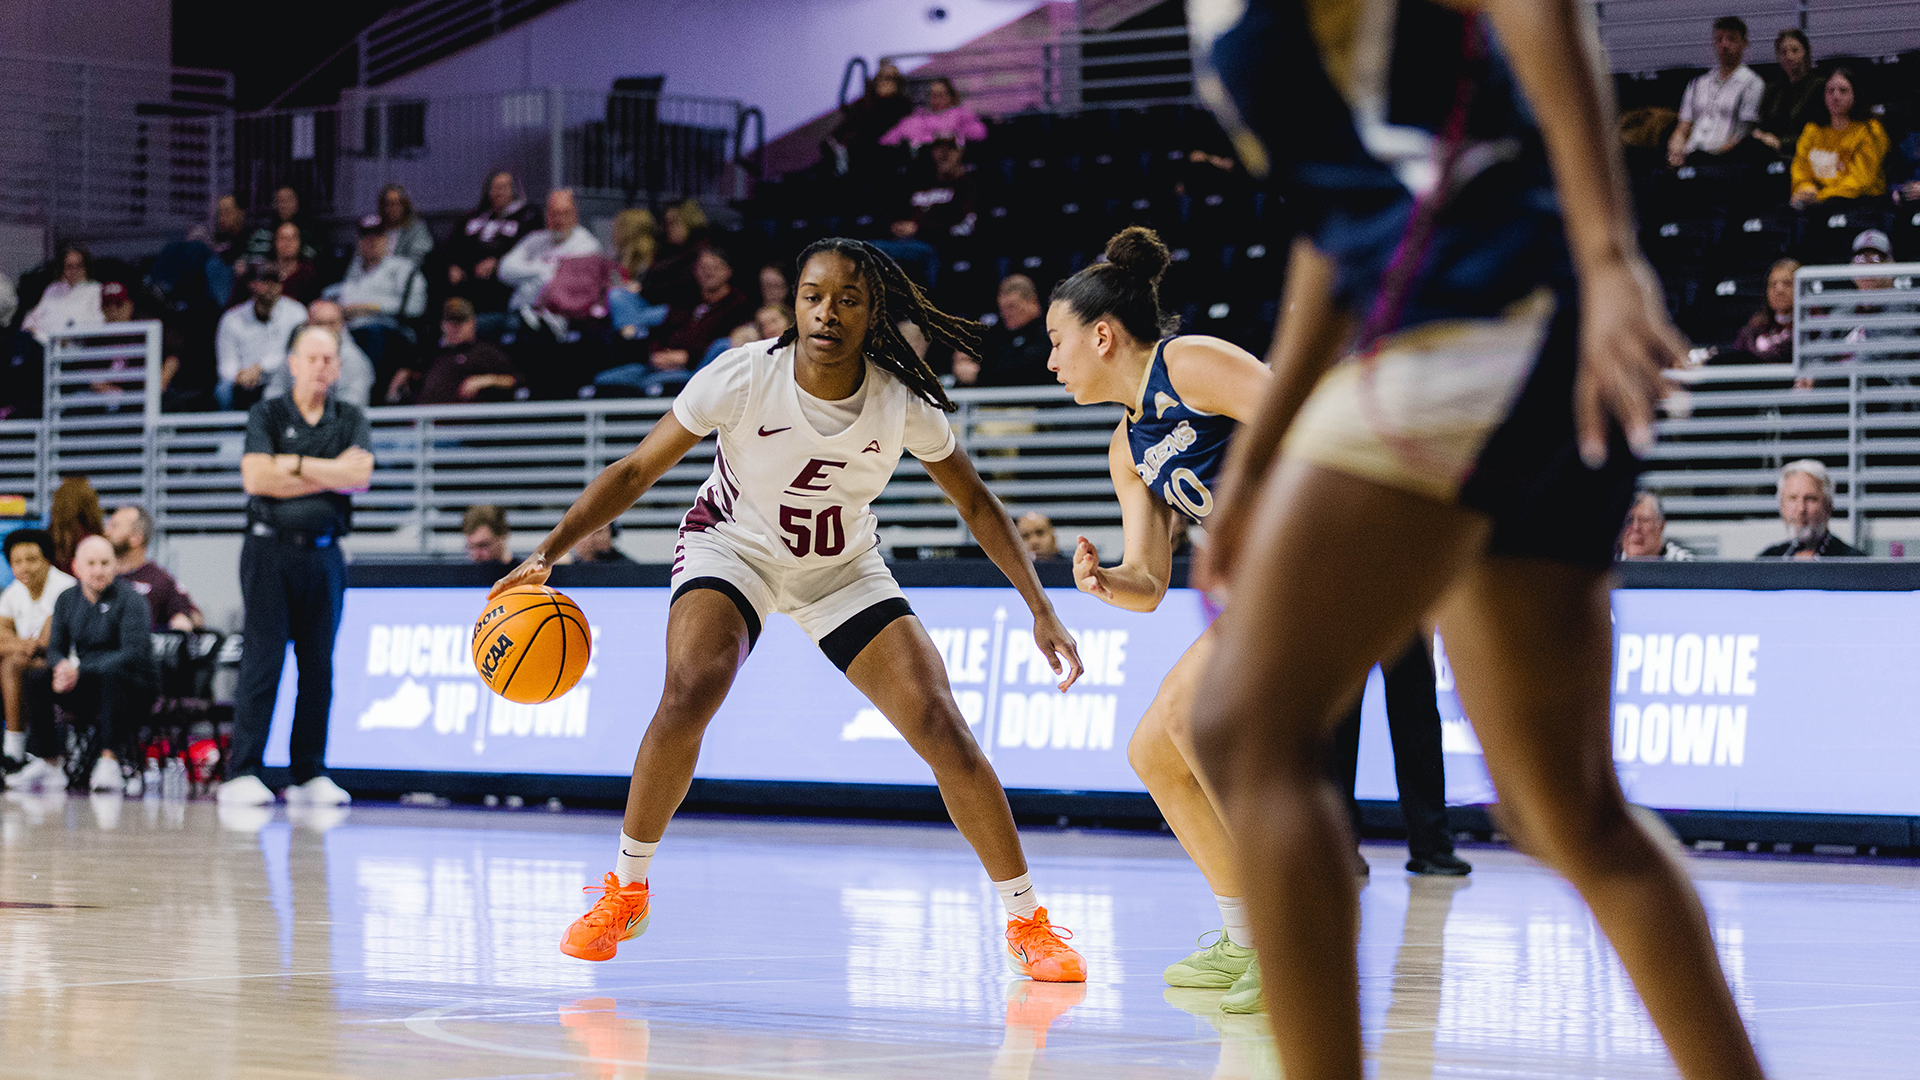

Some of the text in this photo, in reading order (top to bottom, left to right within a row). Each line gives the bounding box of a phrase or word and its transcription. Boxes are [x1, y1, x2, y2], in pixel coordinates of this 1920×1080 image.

[789, 458, 848, 491] E
[1163, 467, 1214, 524] 10
[779, 504, 846, 558] 50
[480, 632, 515, 683] NCAA
[1615, 632, 1760, 696] PHONE
[434, 681, 478, 734] UP
[997, 692, 1117, 749] DOWN
[1612, 702, 1748, 766] DOWN
